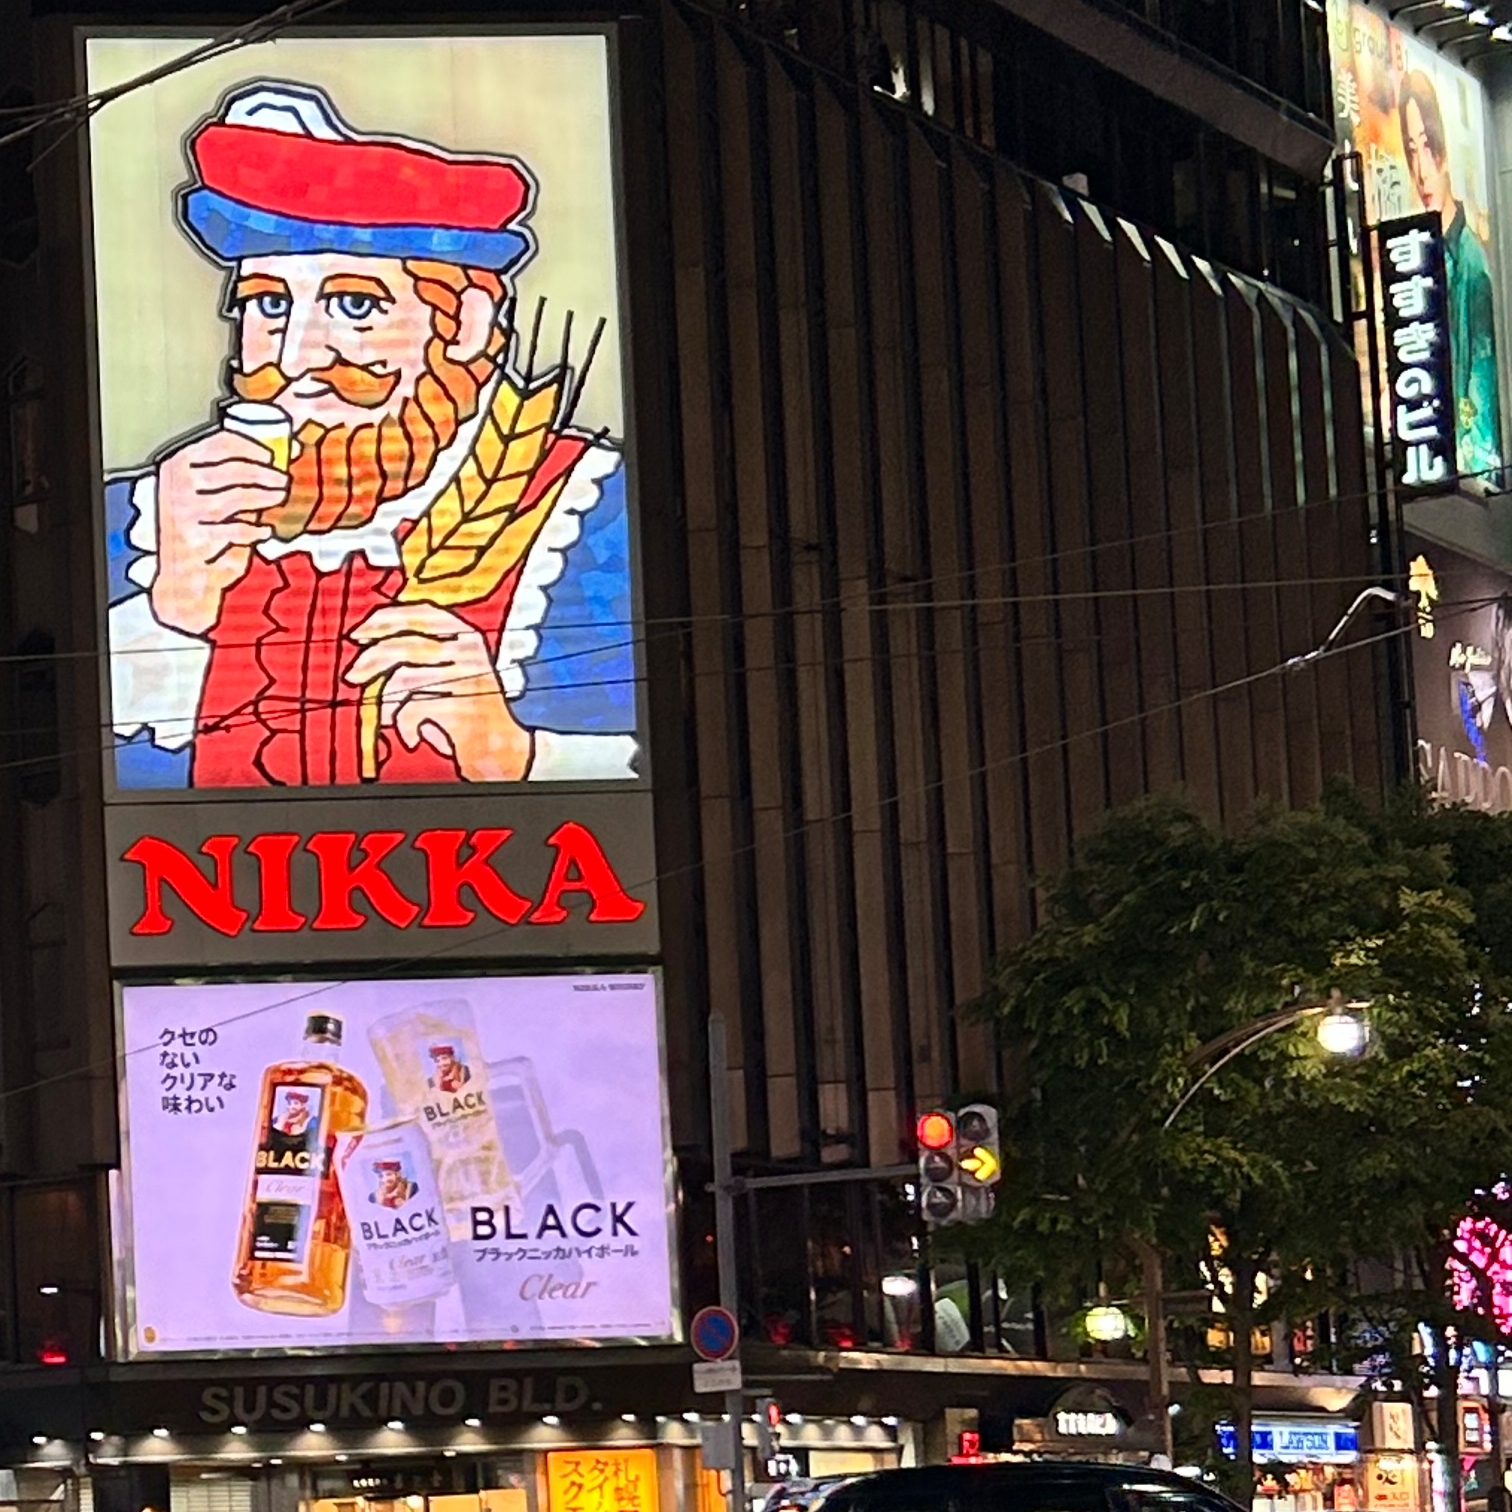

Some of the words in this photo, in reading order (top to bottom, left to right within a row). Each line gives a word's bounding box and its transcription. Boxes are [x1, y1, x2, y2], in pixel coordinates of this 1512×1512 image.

[1386, 229, 1446, 484] すすきのビル
[122, 821, 645, 937] NIKKA
[159, 1027, 218, 1047] クセの
[159, 1050, 200, 1070] ない
[160, 1071, 237, 1092] クリアな
[161, 1093, 225, 1115] 味わい
[422, 1090, 487, 1122] BLACK
[254, 1150, 325, 1171] BLACK
[360, 1206, 440, 1241] BLACK
[469, 1200, 640, 1241] BLACK
[472, 1243, 640, 1263] ブラックニッカハイボール
[518, 1272, 598, 1301] Clear
[198, 1378, 465, 1425] SUSUKINO
[488, 1375, 604, 1413] BLD.
[1278, 1430, 1333, 1450] LAWSON
